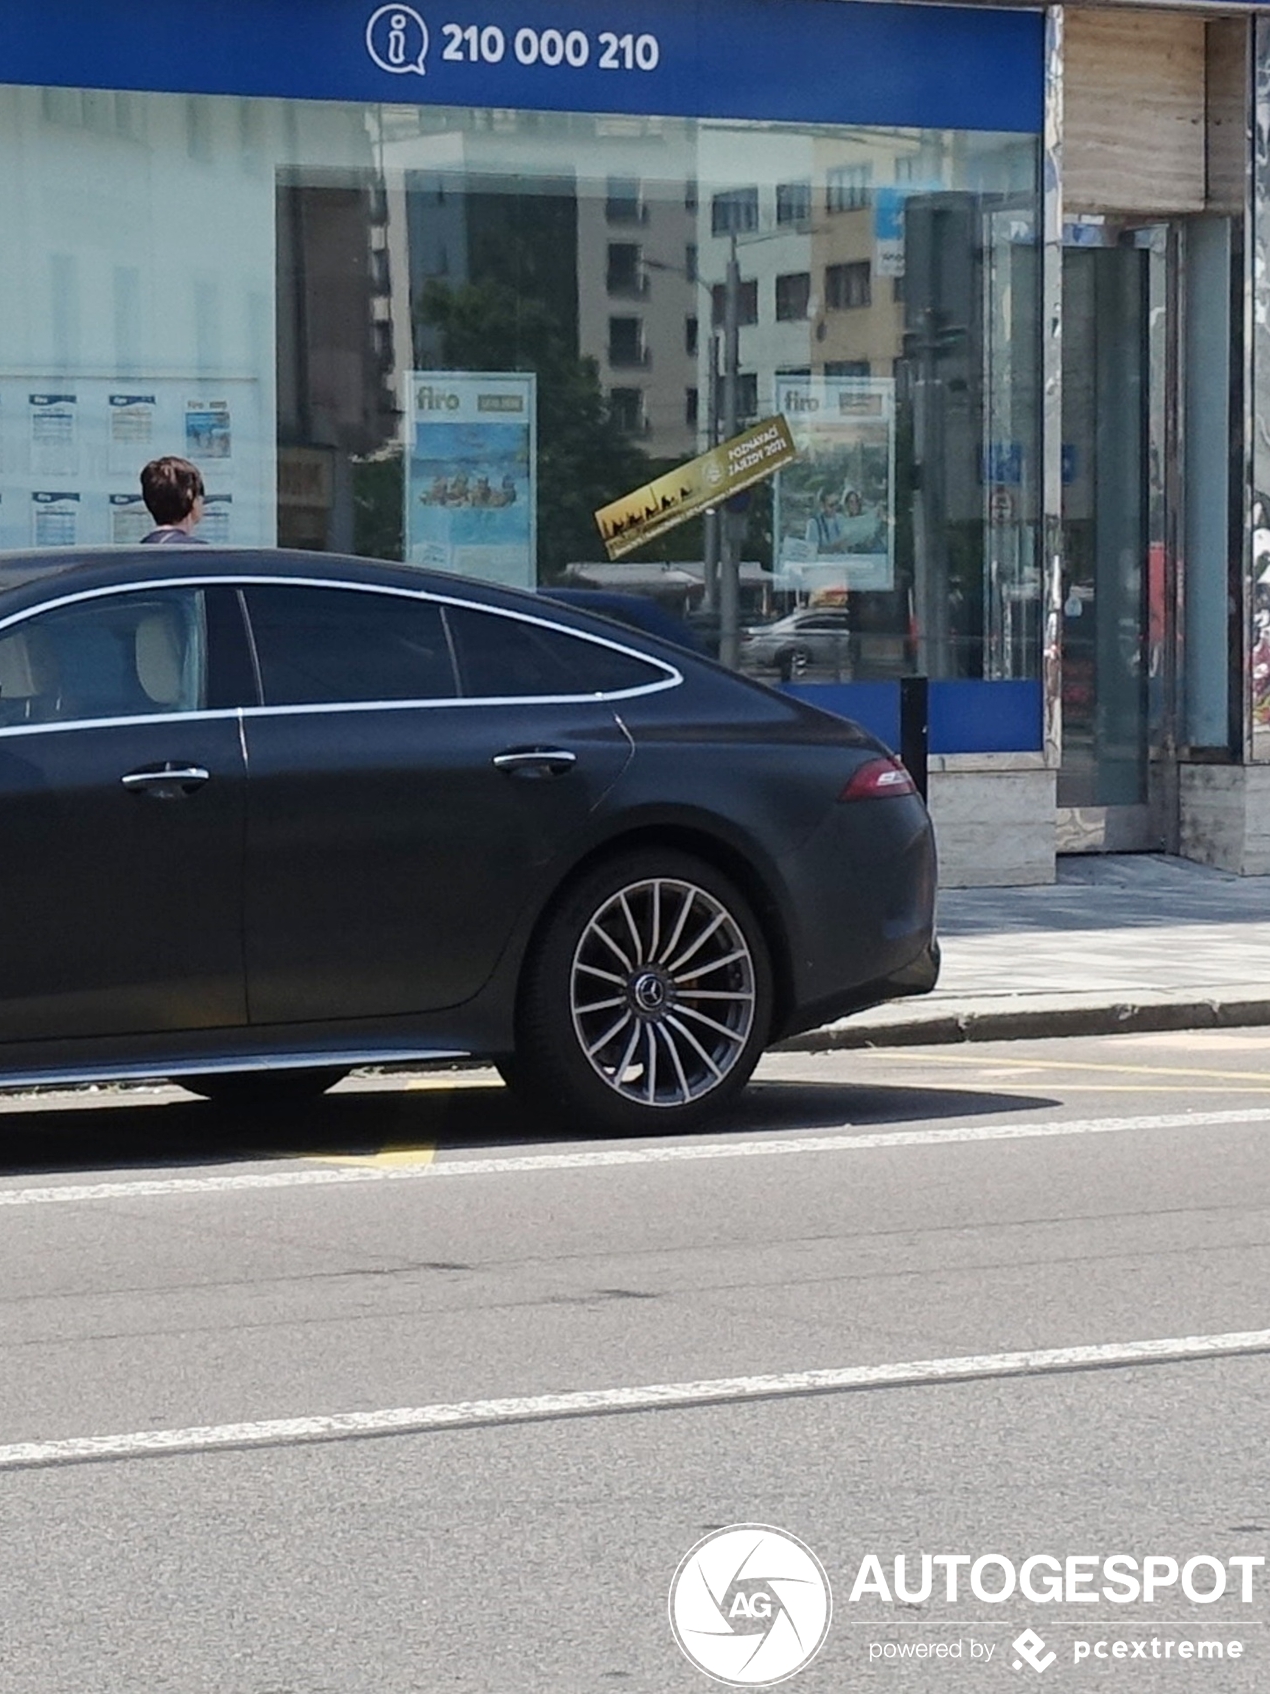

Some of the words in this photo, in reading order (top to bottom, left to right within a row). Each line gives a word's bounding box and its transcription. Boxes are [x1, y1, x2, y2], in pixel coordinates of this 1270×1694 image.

[441, 23, 505, 63] 210
[514, 27, 590, 67] 000
[598, 31, 660, 71] 210
[417, 385, 460, 411] firo
[784, 390, 820, 412] firo
